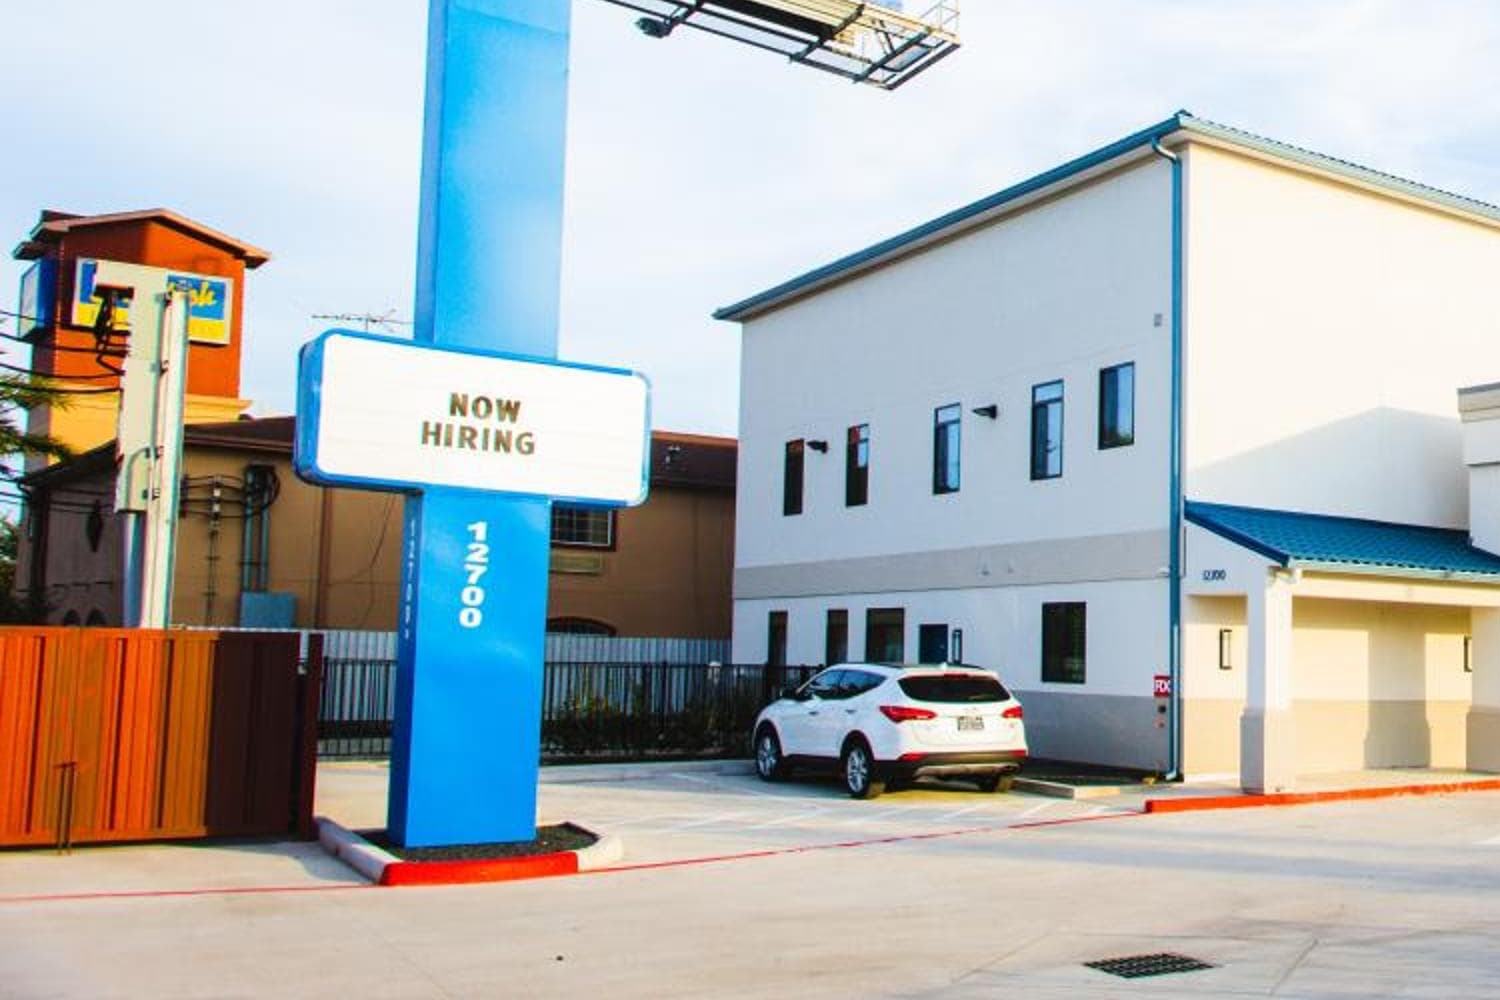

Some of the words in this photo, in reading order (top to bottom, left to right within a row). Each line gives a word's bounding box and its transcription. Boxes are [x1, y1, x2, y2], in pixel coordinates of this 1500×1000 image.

[449, 392, 521, 424] NOW
[421, 420, 536, 456] HIRING
[459, 520, 489, 629] 12700
